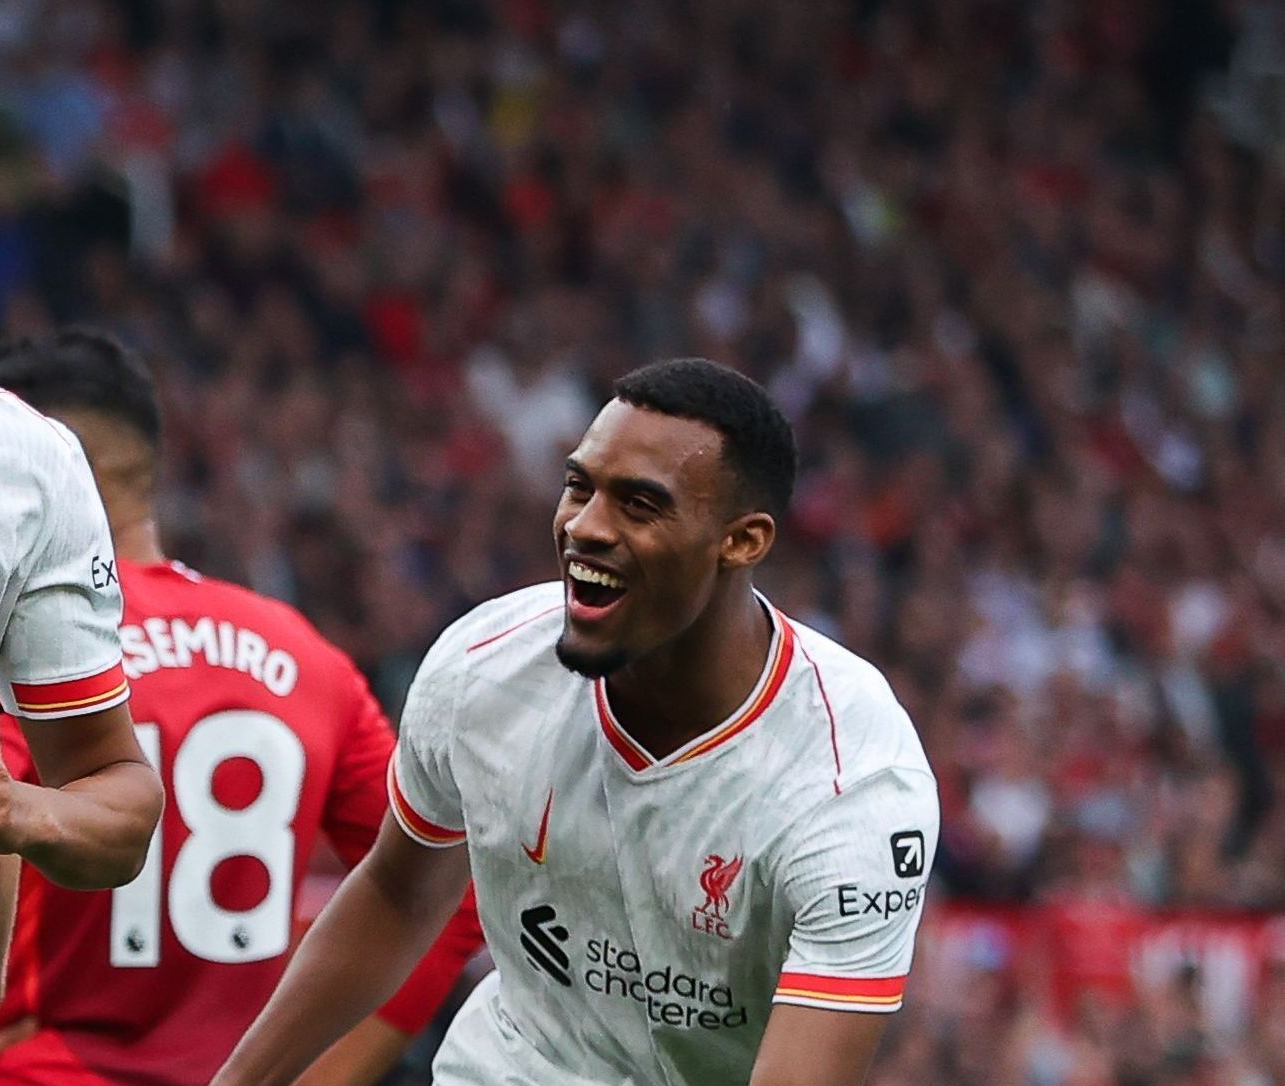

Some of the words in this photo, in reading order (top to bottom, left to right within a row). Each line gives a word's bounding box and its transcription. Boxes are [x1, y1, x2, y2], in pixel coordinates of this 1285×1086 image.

[118, 616, 299, 697] SEMIRO
[584, 969, 748, 1031] chatered
[586, 939, 734, 1008] stadard
